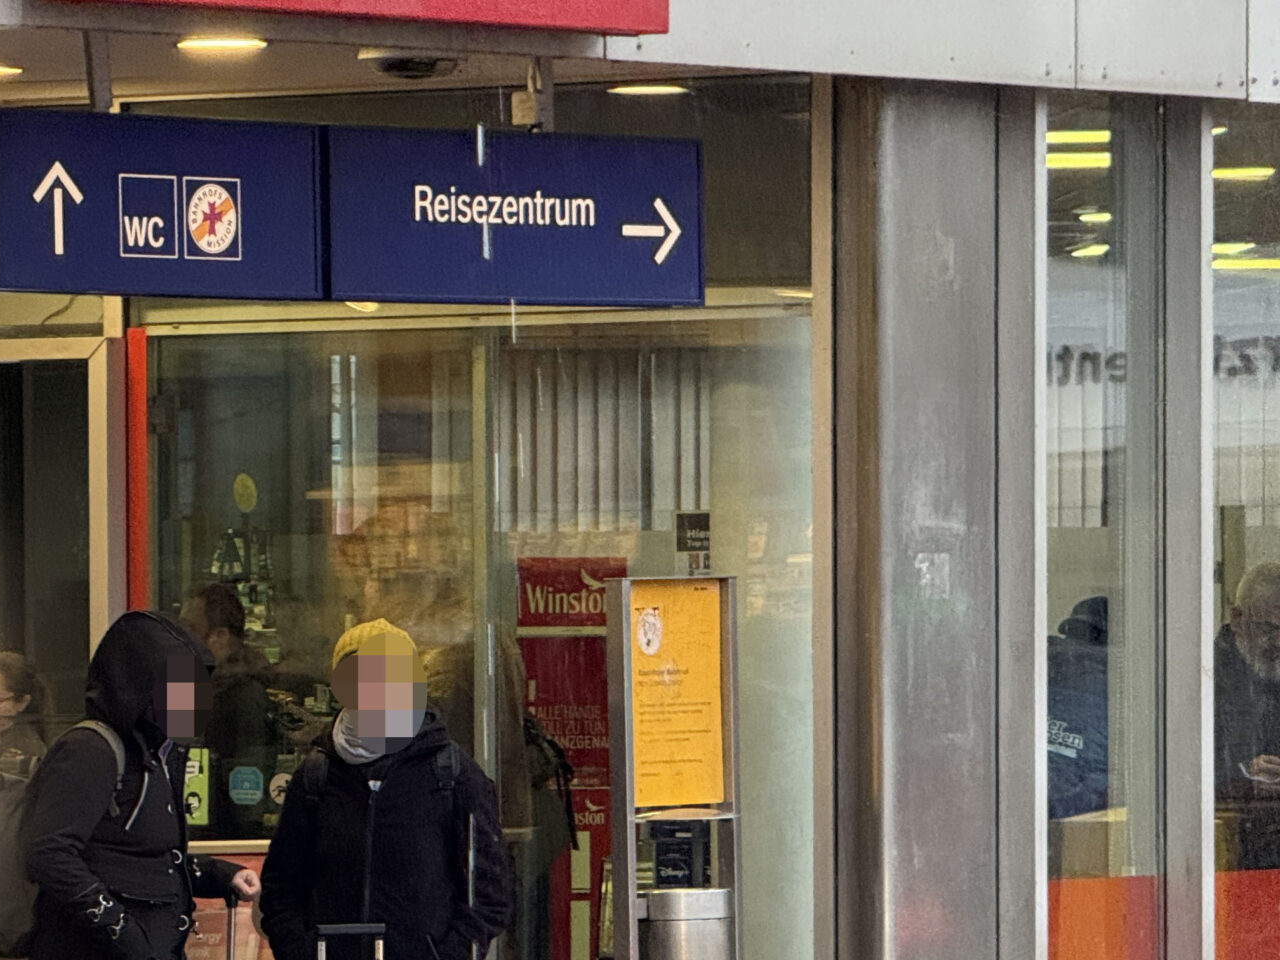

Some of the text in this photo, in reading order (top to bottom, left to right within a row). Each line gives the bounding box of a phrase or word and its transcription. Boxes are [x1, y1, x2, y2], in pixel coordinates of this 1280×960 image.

[191, 188, 223, 224] BAHNHOFS
[414, 184, 596, 227] Reisezentrum
[123, 215, 165, 248] WC
[206, 219, 233, 249] MISSION
